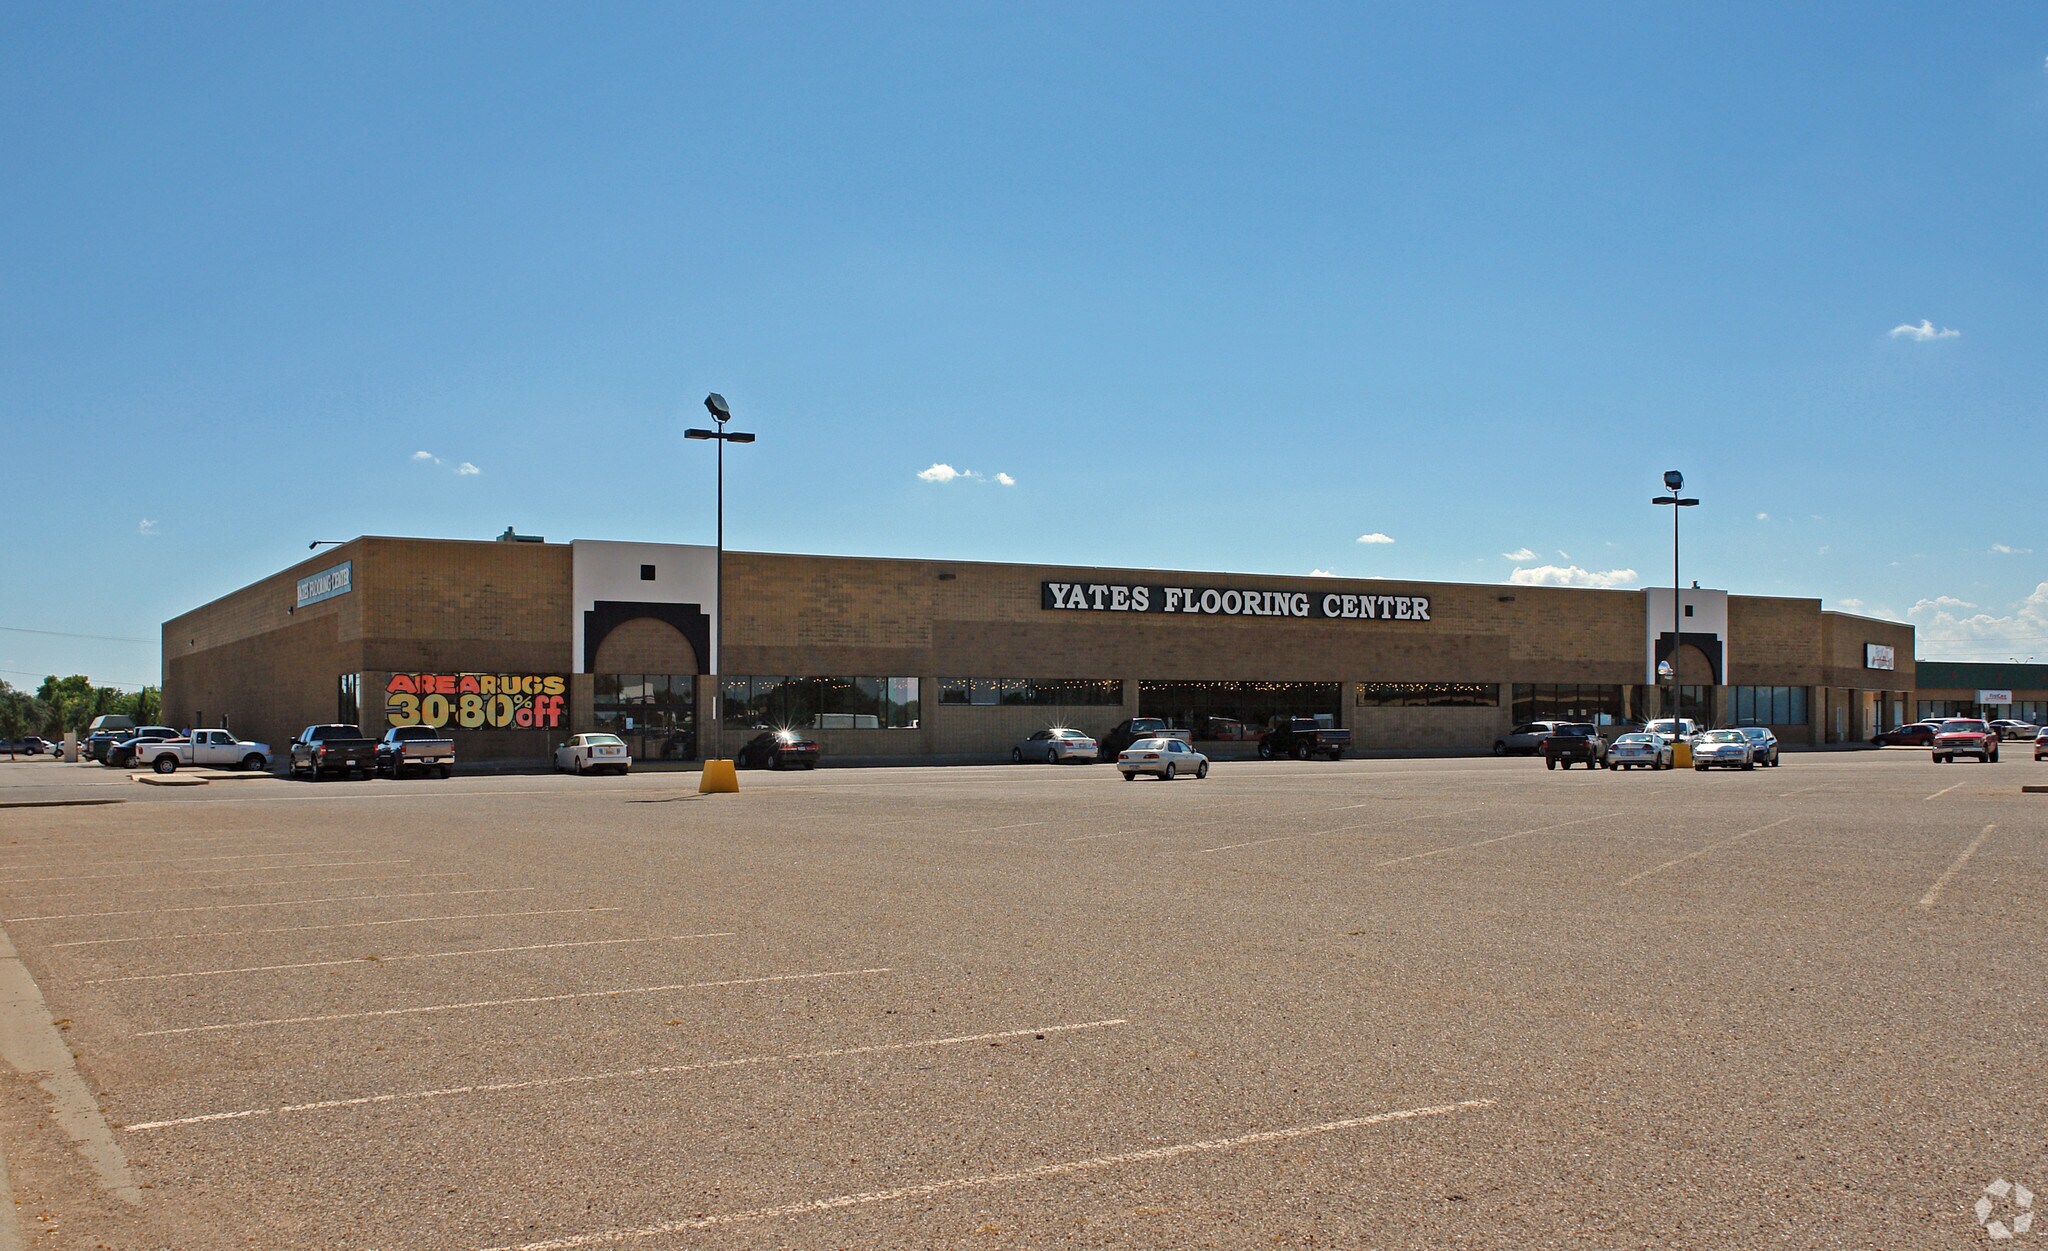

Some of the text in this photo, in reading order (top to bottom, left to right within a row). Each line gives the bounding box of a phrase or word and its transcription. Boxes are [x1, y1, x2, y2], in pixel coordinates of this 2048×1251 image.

[309, 574, 331, 598] FLOORING
[331, 567, 350, 590] CENTER
[1048, 583, 1431, 621] YATES FLOORING CENTER
[386, 674, 566, 695] AREA RUGS
[515, 694, 565, 728] off
